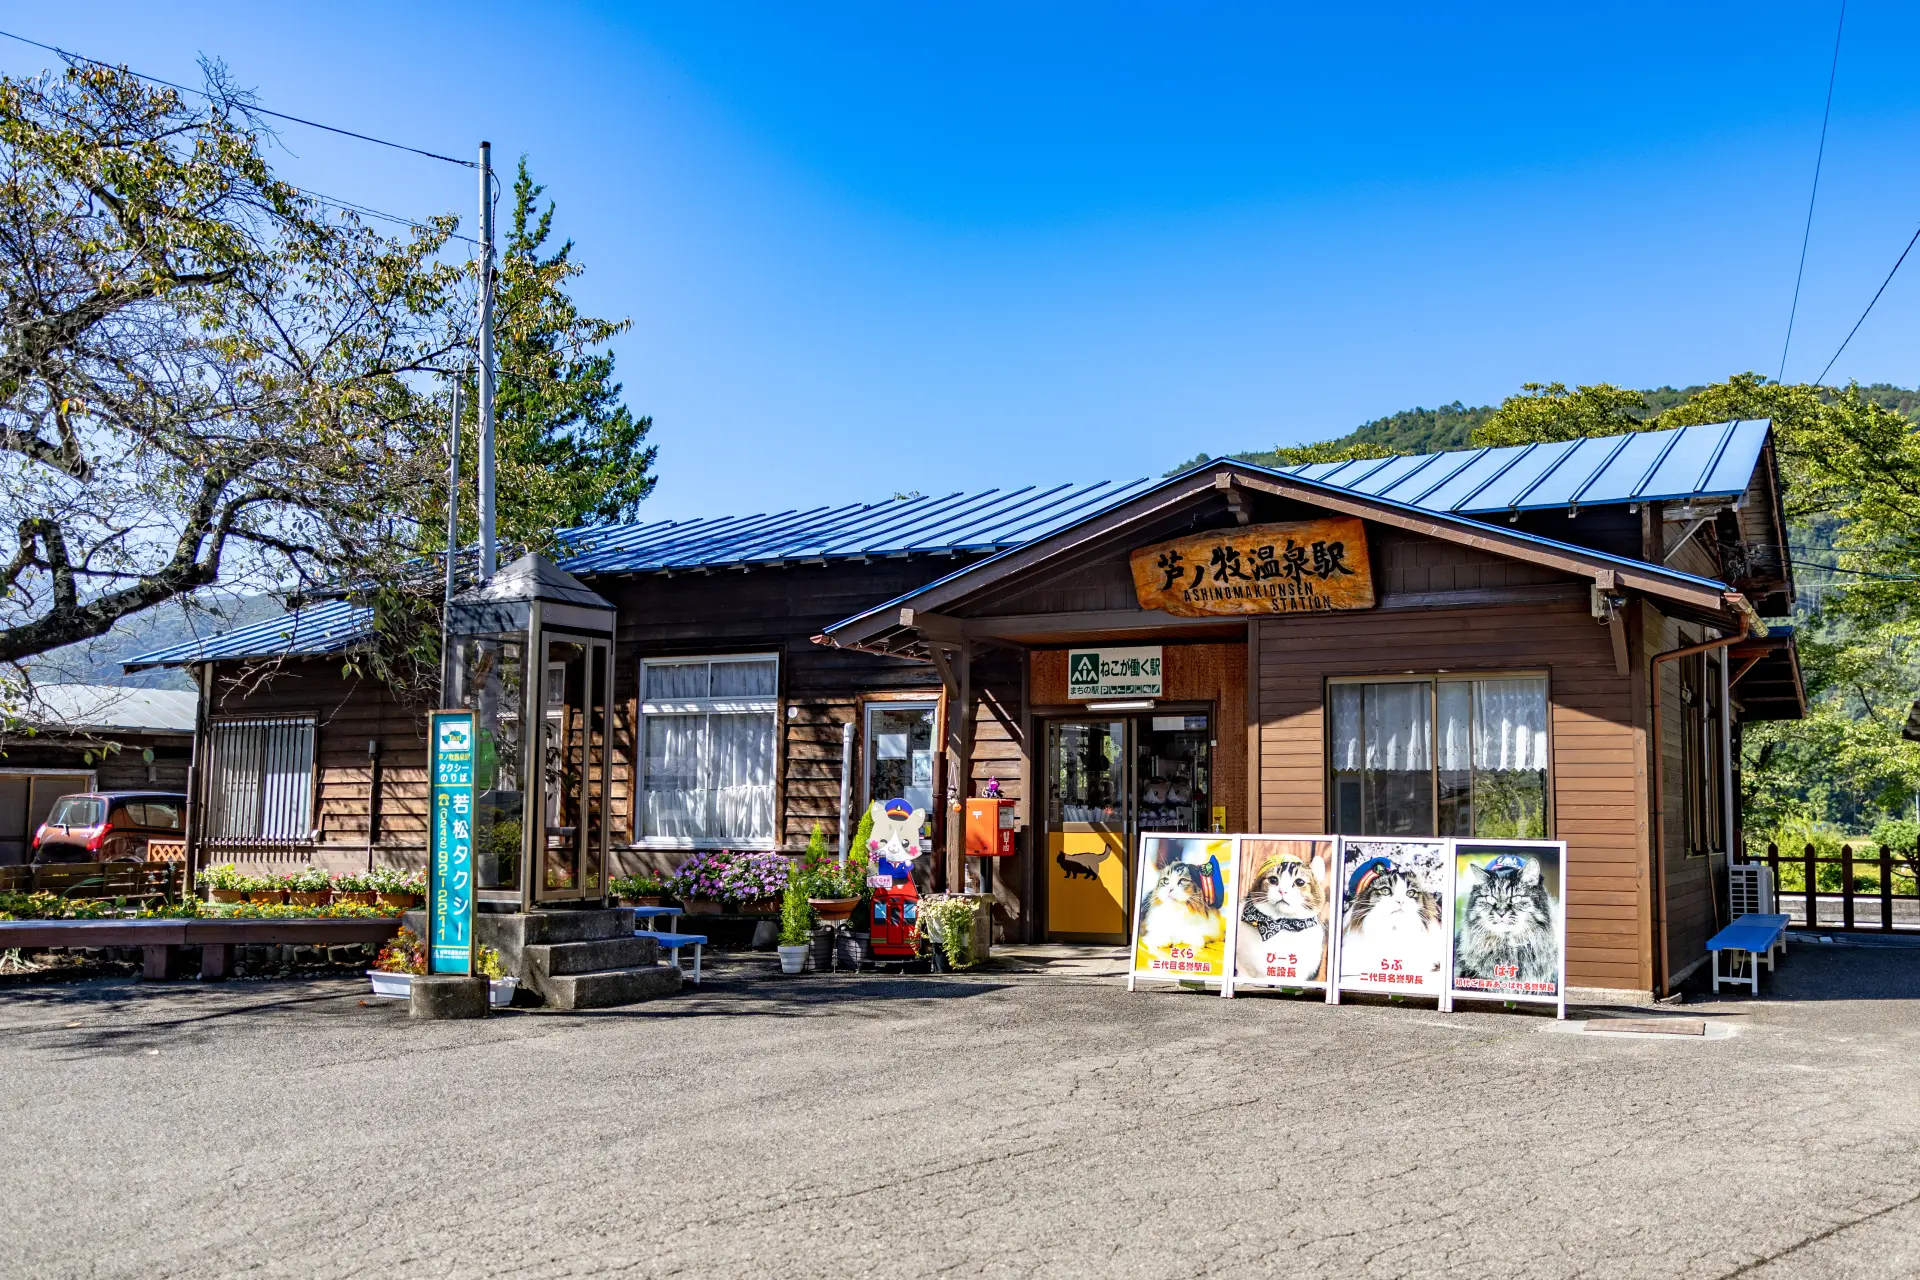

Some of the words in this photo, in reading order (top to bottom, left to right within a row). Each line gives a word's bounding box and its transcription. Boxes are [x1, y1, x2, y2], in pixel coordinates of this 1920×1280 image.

[1157, 539, 1354, 591] 芦ノ牧温泉駅
[1183, 582, 1314, 602] ASHINOMAKIONSEN
[1272, 596, 1332, 612] STATION
[1100, 657, 1160, 677] ねこが働く駅
[1070, 685, 1099, 695] まちの駅
[439, 763, 469, 773] タクシー
[440, 772, 468, 783] のりば
[452, 793, 470, 941] 若松タクシー
[1171, 947, 1194, 959] さくら
[1153, 960, 1211, 972] 三代目名誉駅長
[1381, 958, 1403, 971] らぶ
[1266, 966, 1297, 978] 施設長
[1494, 965, 1518, 978] ばす
[1360, 972, 1423, 985] 二代目名誉駅長
